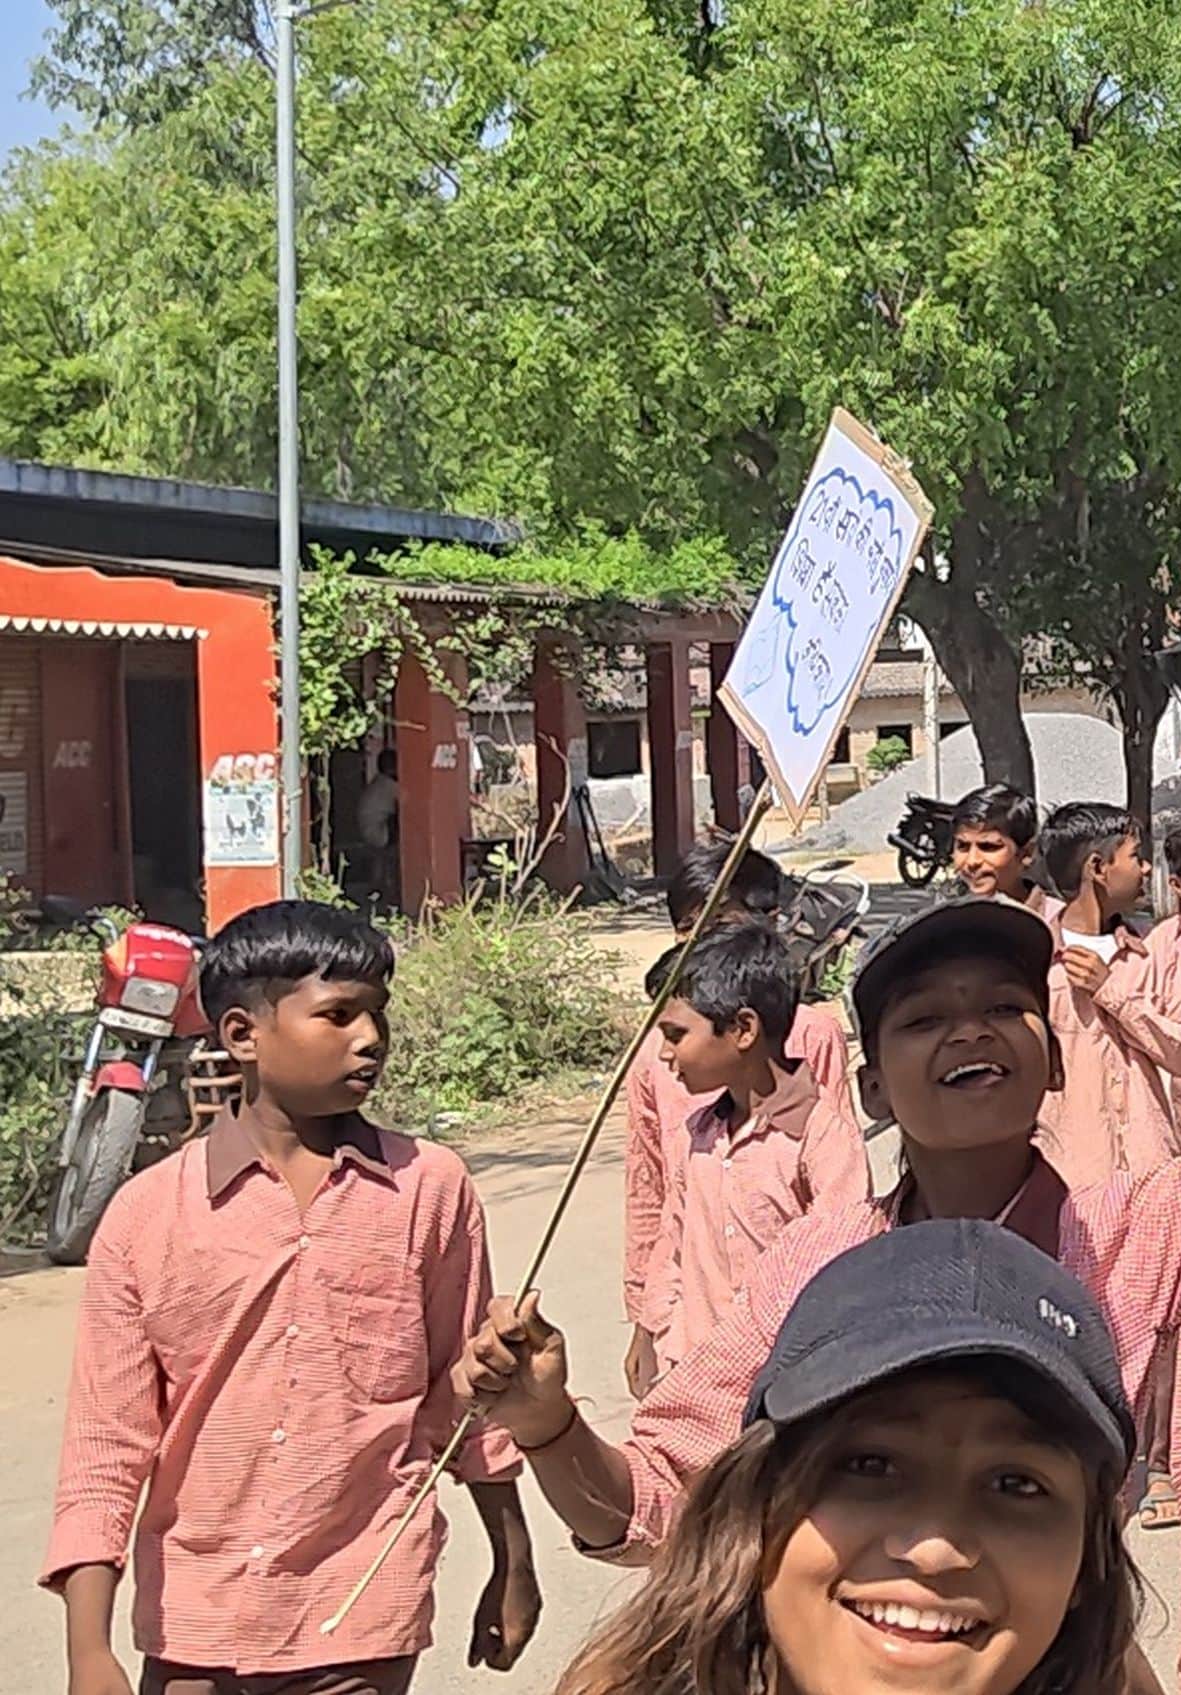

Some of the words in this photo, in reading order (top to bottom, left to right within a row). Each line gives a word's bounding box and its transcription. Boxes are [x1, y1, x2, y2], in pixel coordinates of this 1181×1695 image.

[53, 740, 93, 769] ACC
[208, 753, 277, 783] ACC
[432, 744, 457, 769] ACC
